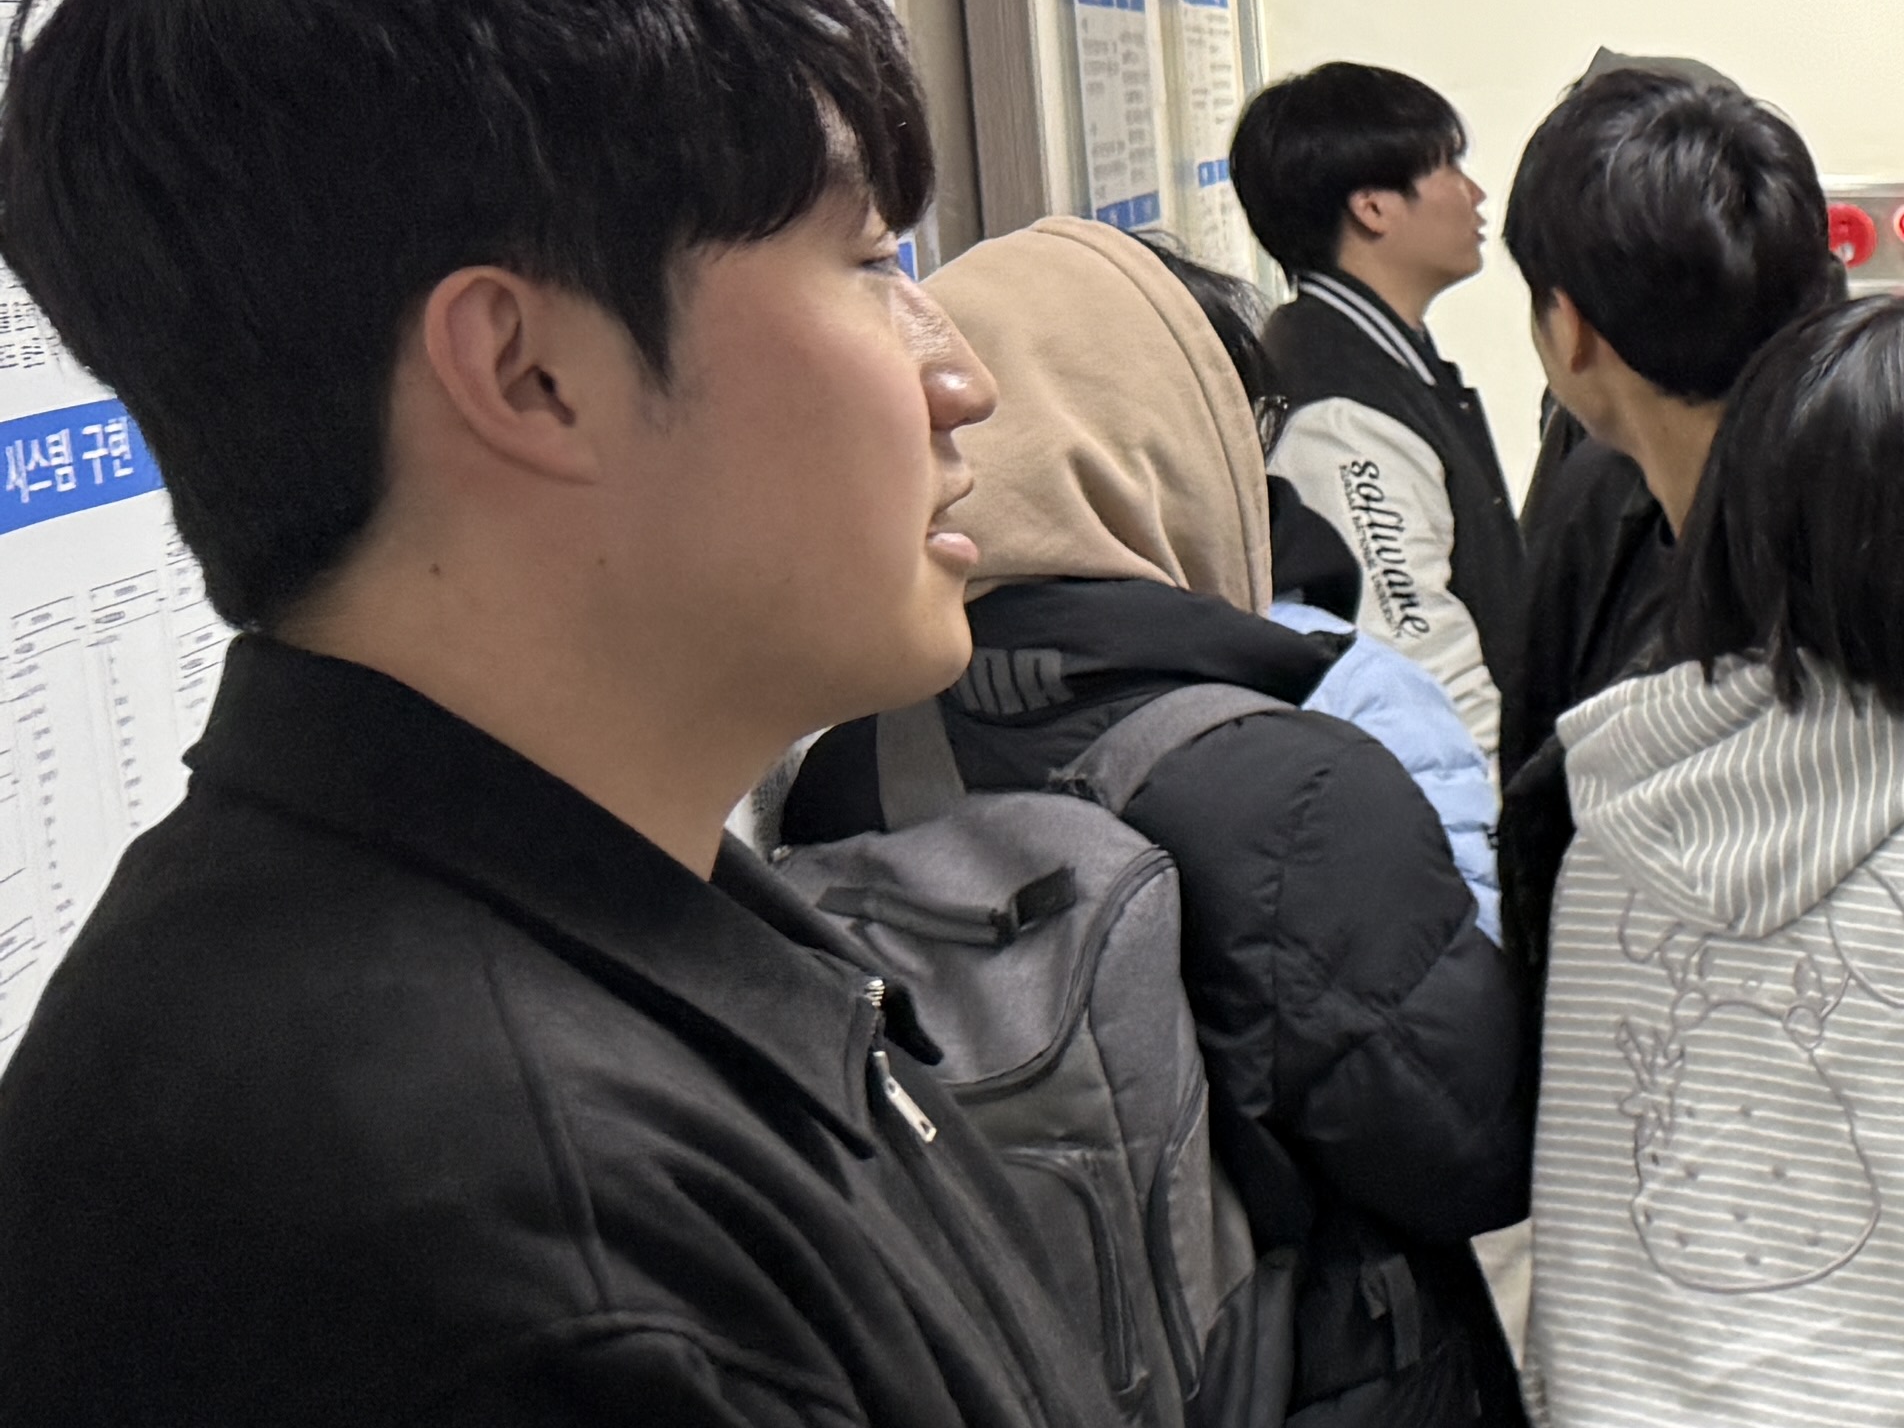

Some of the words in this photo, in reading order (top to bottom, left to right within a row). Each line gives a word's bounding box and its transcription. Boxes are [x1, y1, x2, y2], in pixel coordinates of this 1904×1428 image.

[5, 428, 76, 504] 시스템
[82, 415, 135, 485] 구현
[1351, 461, 1430, 639] software
